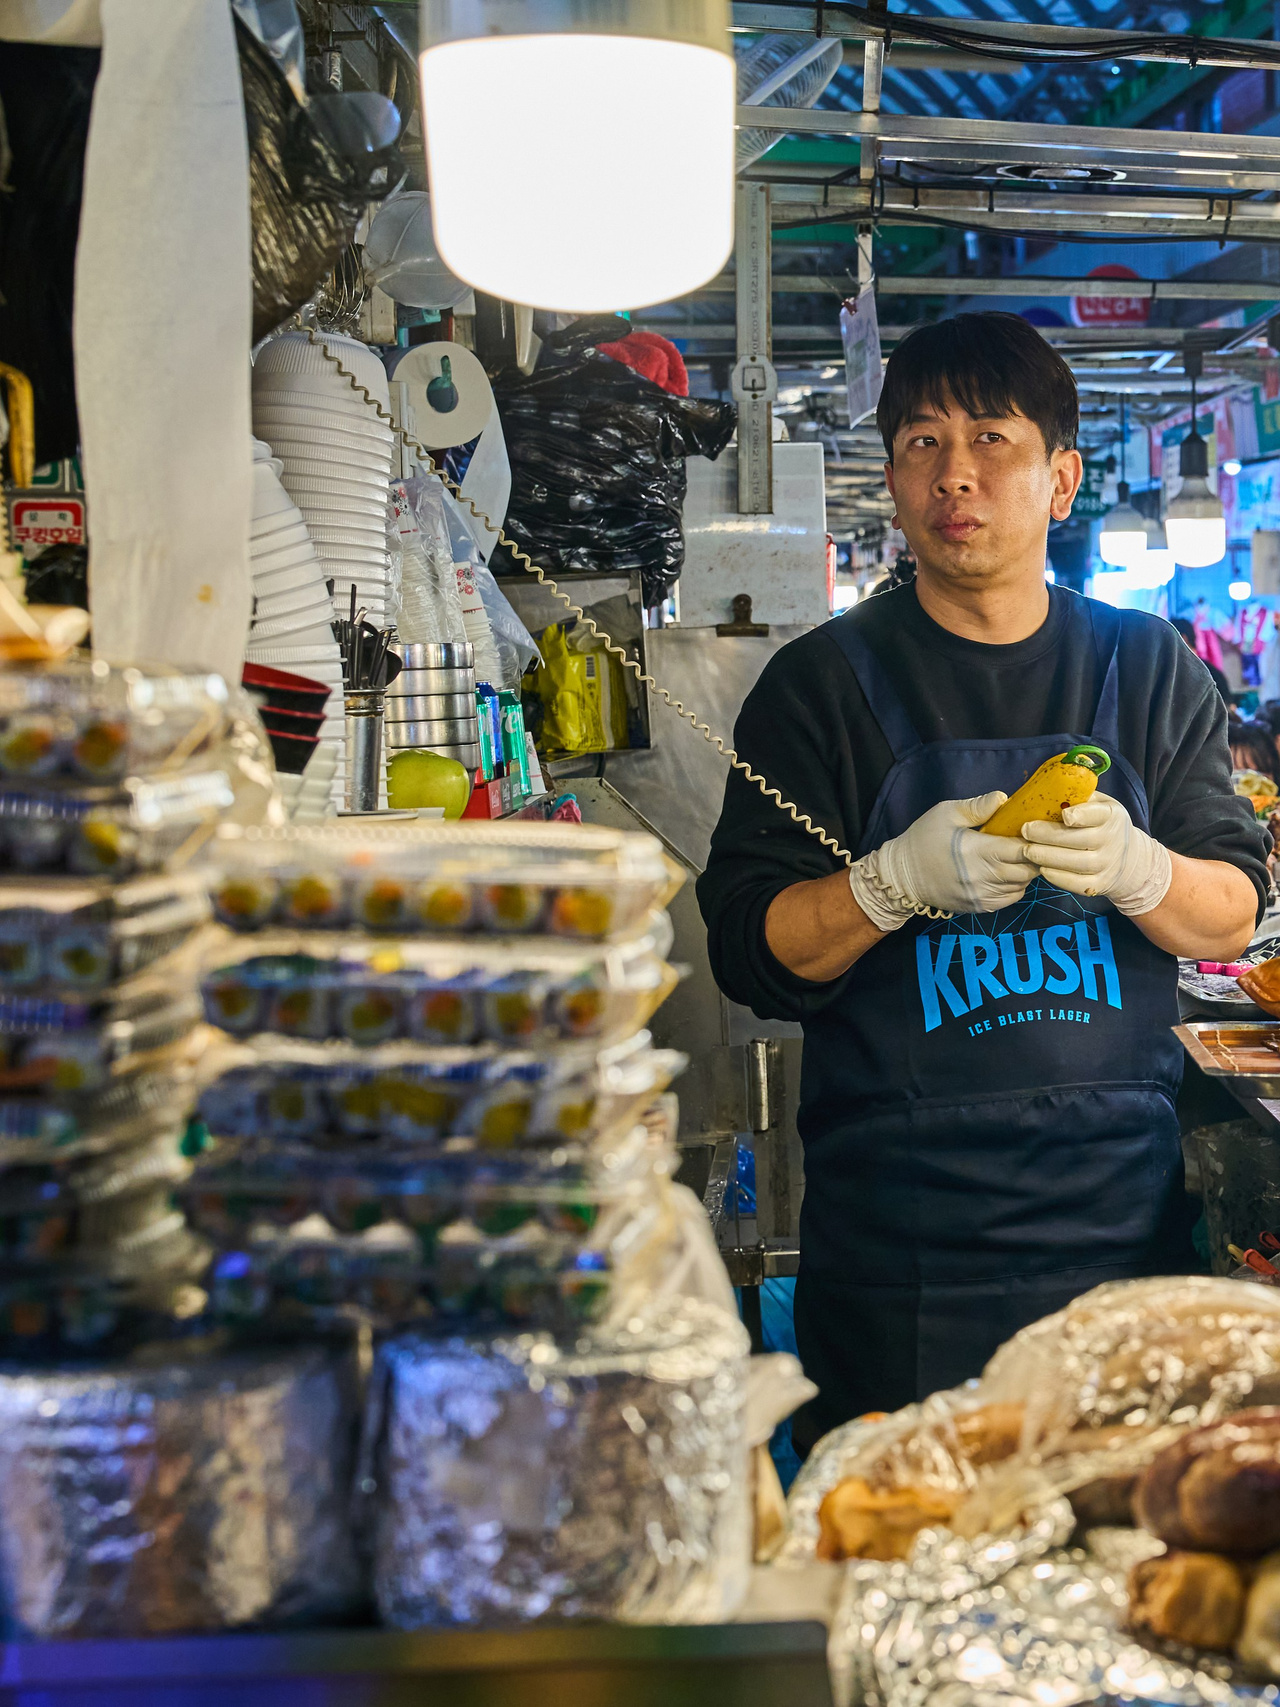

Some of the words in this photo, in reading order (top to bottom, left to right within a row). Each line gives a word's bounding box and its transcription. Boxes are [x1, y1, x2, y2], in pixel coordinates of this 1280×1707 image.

[916, 916, 1122, 1033] KRUSH
[968, 1018, 992, 1037] ICE
[998, 1009, 1042, 1027] BLAST
[1050, 1008, 1091, 1024] LAGER
